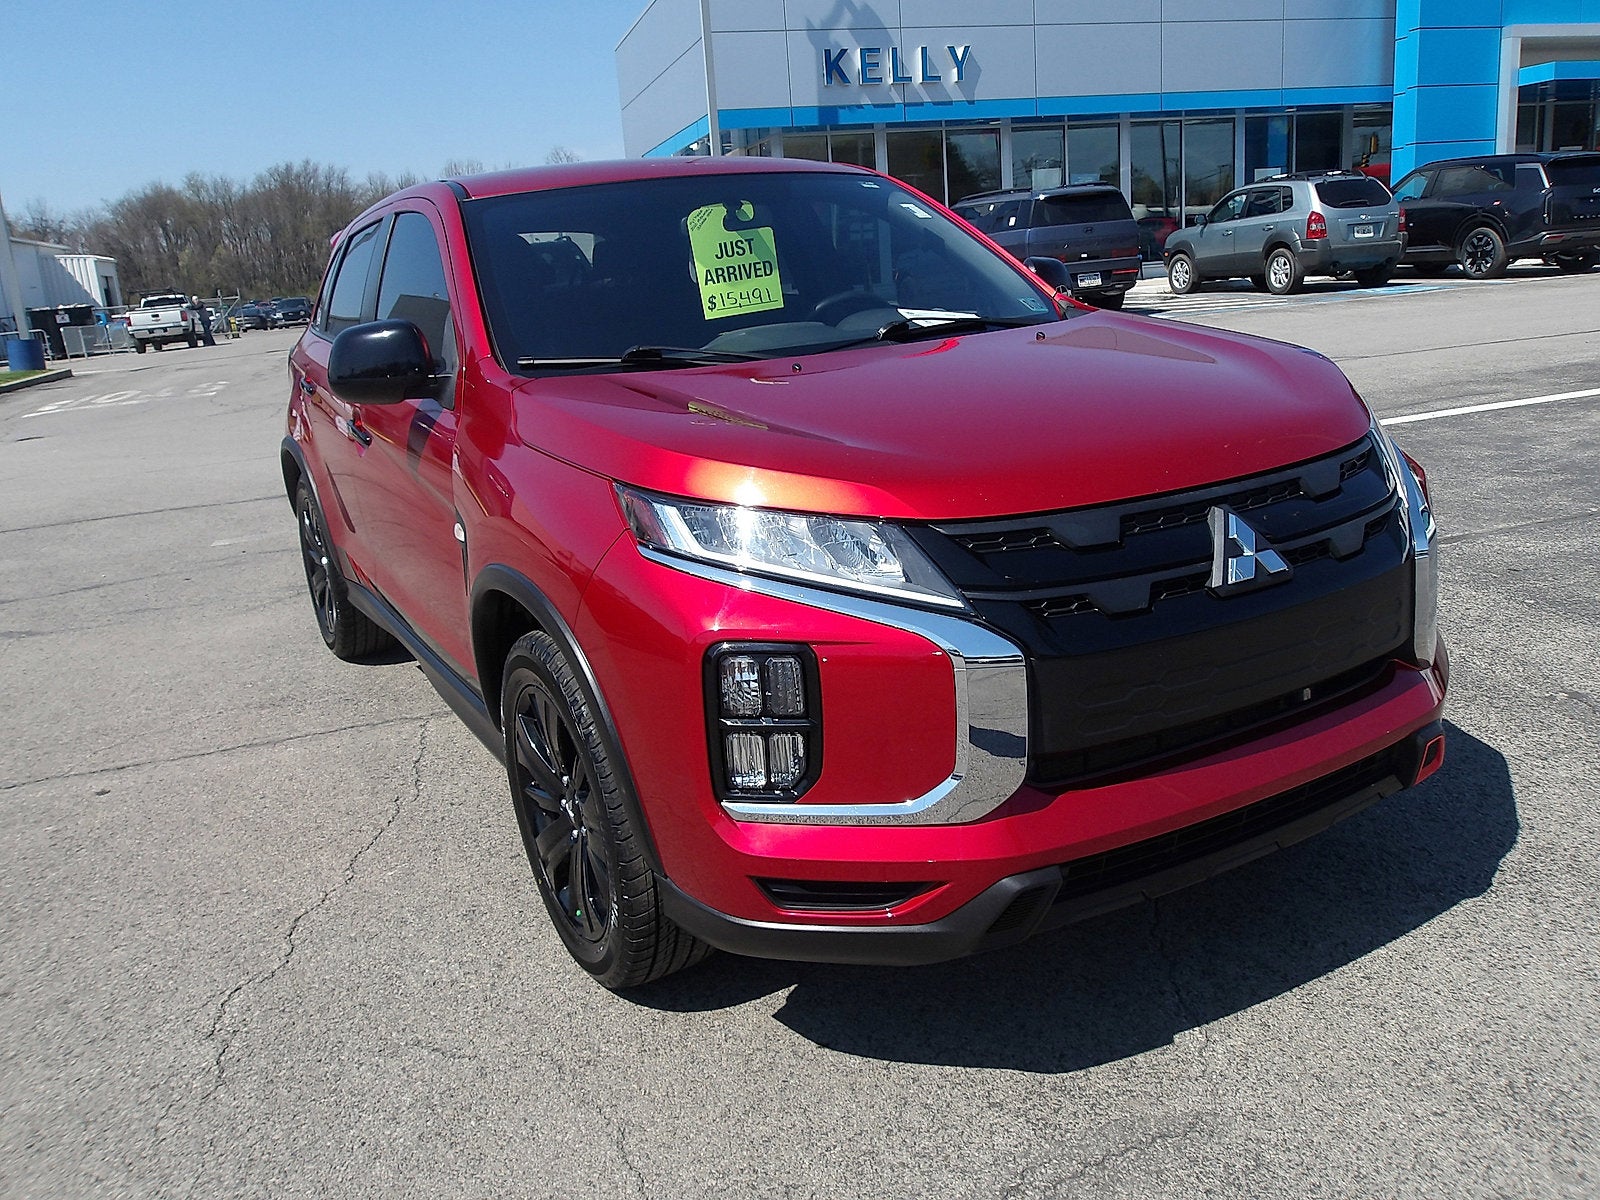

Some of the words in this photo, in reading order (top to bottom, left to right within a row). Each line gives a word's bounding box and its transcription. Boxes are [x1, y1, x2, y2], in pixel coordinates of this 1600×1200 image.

[823, 45, 971, 86] KELLY
[715, 238, 755, 260] JUST
[704, 260, 774, 286] ARRIVED
